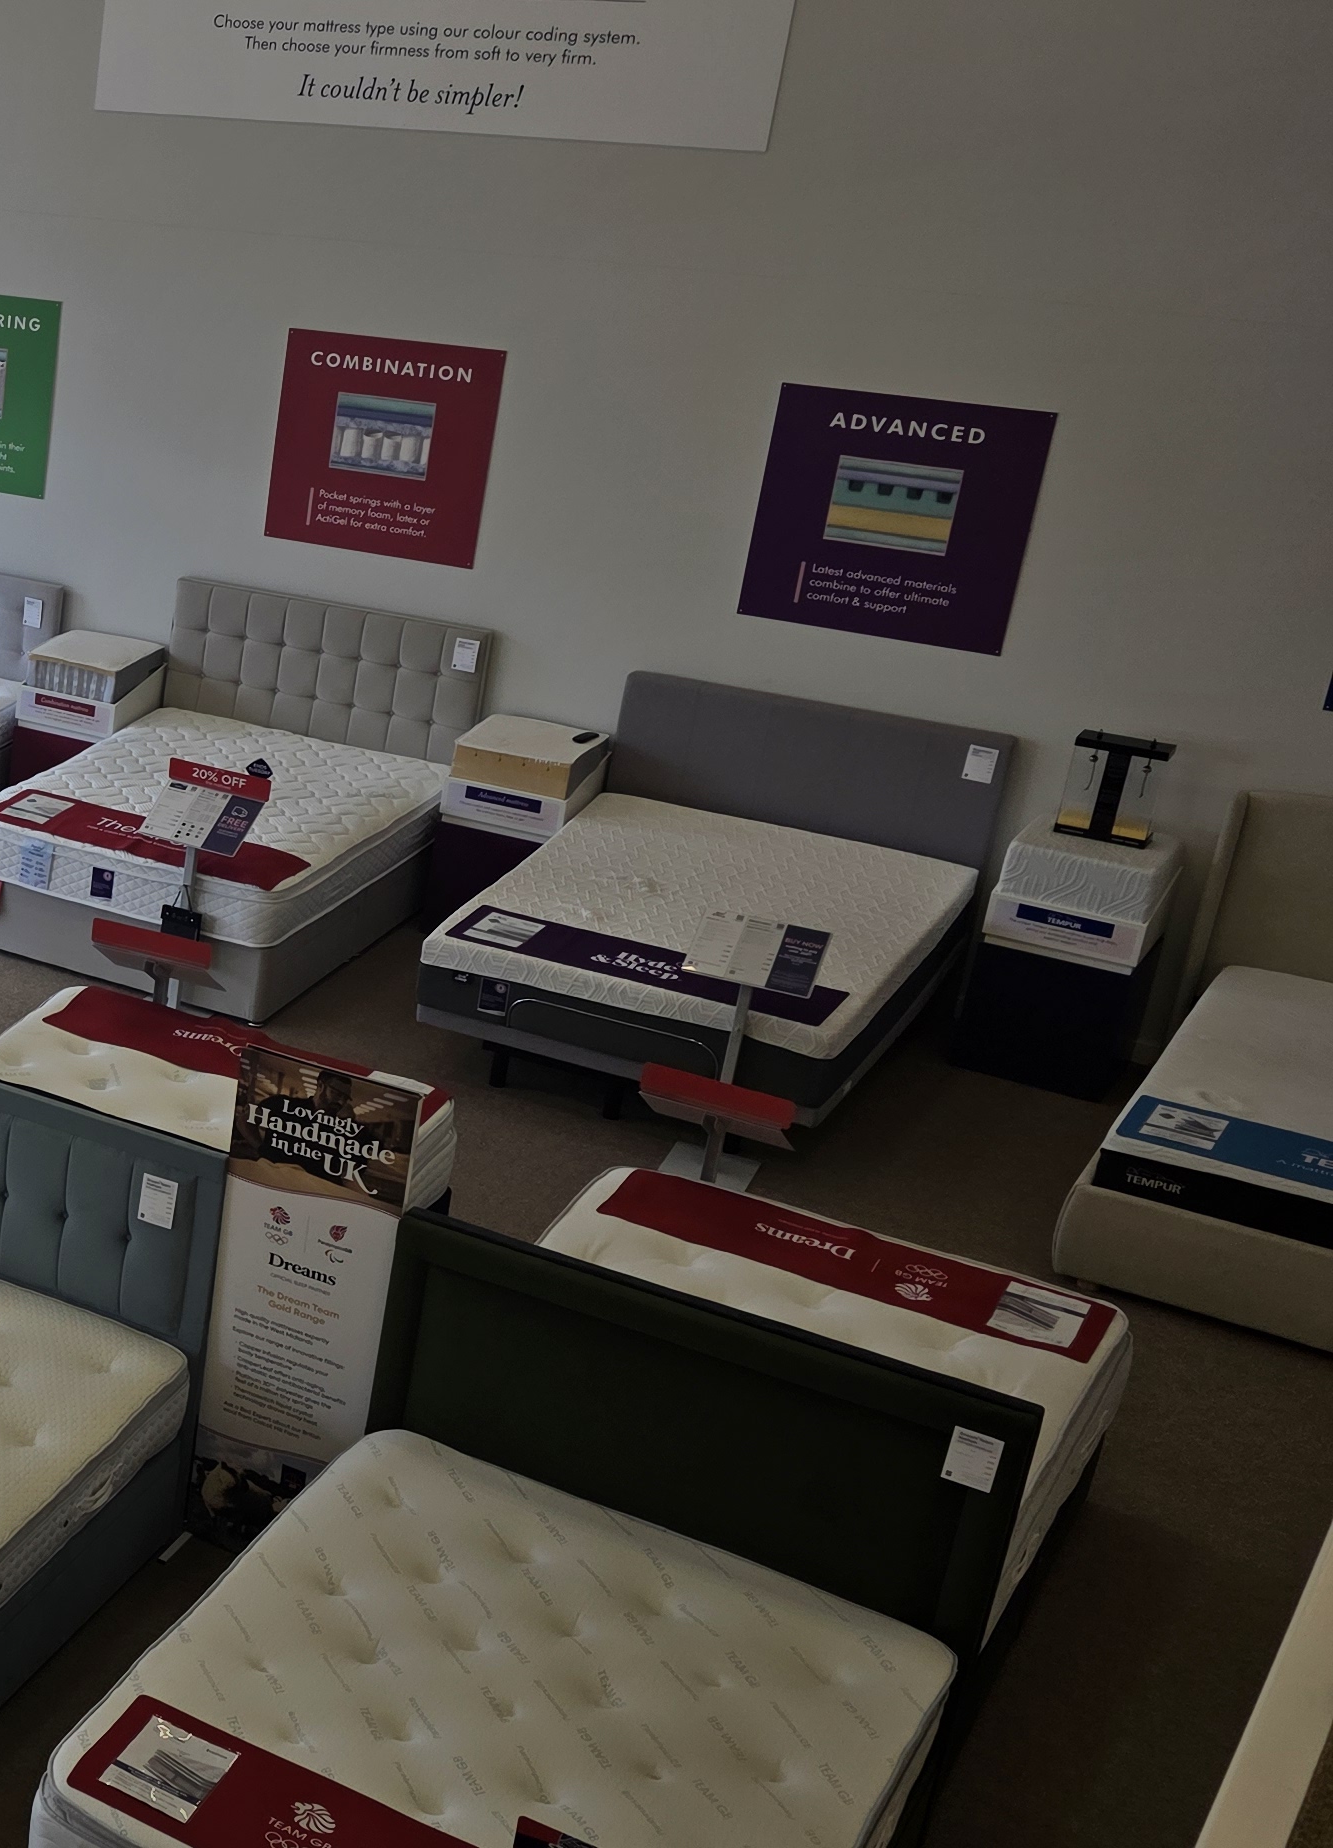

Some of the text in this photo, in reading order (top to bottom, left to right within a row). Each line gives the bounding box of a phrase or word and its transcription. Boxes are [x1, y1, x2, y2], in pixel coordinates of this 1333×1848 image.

[213, 14, 640, 47] Choose your mattress type using our colour coding system.
[244, 36, 596, 67] Then choose your firmness from soft to very firm.
[297, 74, 525, 115] It couldn't be simpler!
[310, 351, 472, 383] COMBINATION
[829, 412, 986, 445] ADVANCED
[0, 440, 7, 449] in
[8, 441, 25, 452] their
[317, 501, 430, 527] of memory foam, latex or
[319, 488, 347, 501] Pocket
[349, 494, 381, 508] springs
[383, 499, 402, 510] with
[413, 502, 436, 515] layer
[315, 513, 426, 538] ActiGel for extra comfort.
[812, 563, 957, 595] Latest advanced materials
[806, 591, 907, 614] comfort & support
[809, 578, 950, 608] combine to offer ultimate
[191, 767, 219, 783] 20%
[221, 774, 247, 789] OFF
[219, 815, 249, 829] FREE
[1047, 916, 1082, 930] TEMPUR
[590, 954, 679, 980] & Sleep
[616, 951, 678, 971] Hyde
[172, 1029, 242, 1057] Dreams
[282, 1098, 365, 1137] Lovingly
[246, 1103, 396, 1165] Handmade
[270, 1133, 379, 1195] in the UK
[1125, 1173, 1182, 1195] TEMPUR
[264, 1222, 282, 1233] TEAM
[754, 1222, 857, 1260] Dreams
[268, 1252, 337, 1286] Dreams
[257, 1285, 340, 1320] The Dream Team
[268, 1300, 326, 1325] Gold Range
[268, 1816, 308, 1840] TEAM
